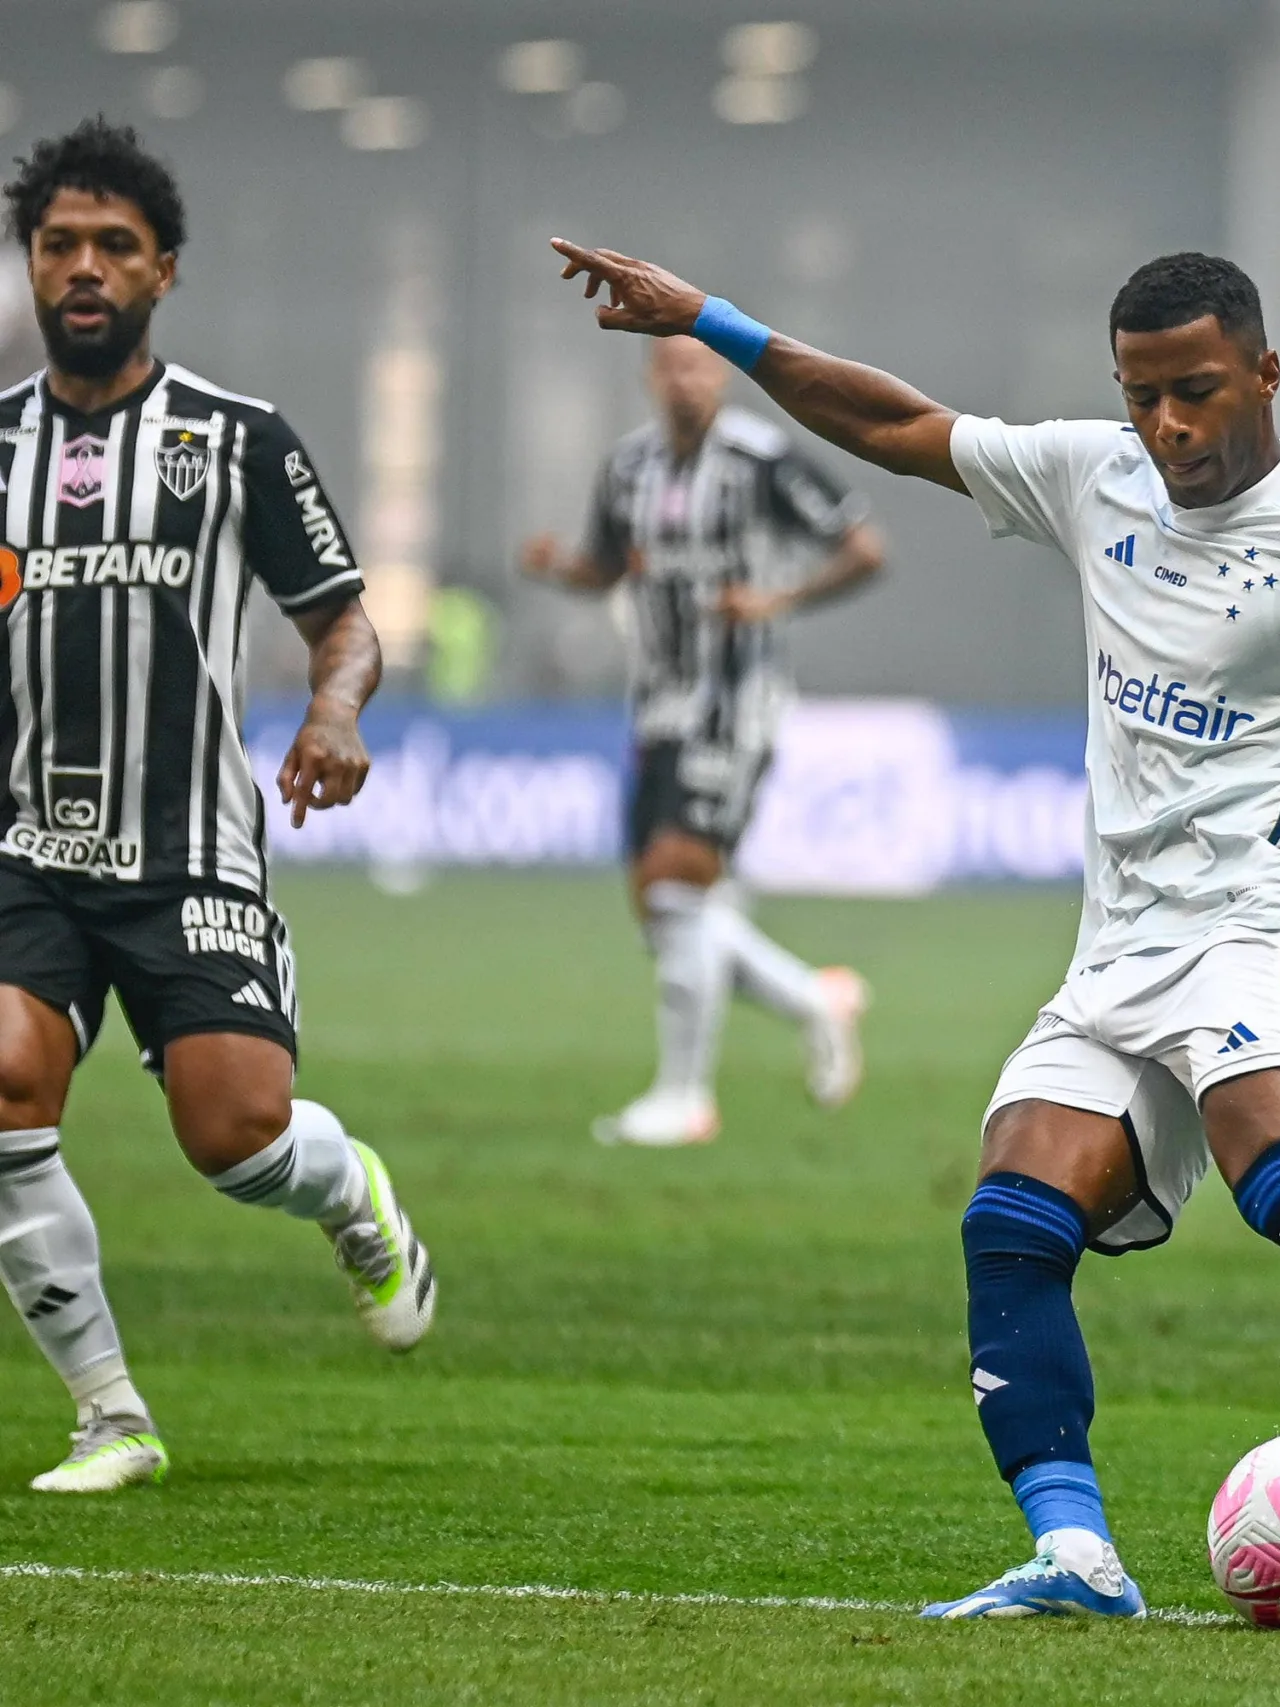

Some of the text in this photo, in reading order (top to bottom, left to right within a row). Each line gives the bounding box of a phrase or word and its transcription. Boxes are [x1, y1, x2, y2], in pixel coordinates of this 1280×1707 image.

[295, 486, 348, 567] MRV
[23, 543, 191, 588] BETANO
[1154, 565, 1187, 588] CIMED
[1103, 654, 1255, 742] betfair
[15, 827, 137, 868] GERDAU
[181, 896, 265, 938] AUTO
[183, 927, 268, 966] TRUCK
